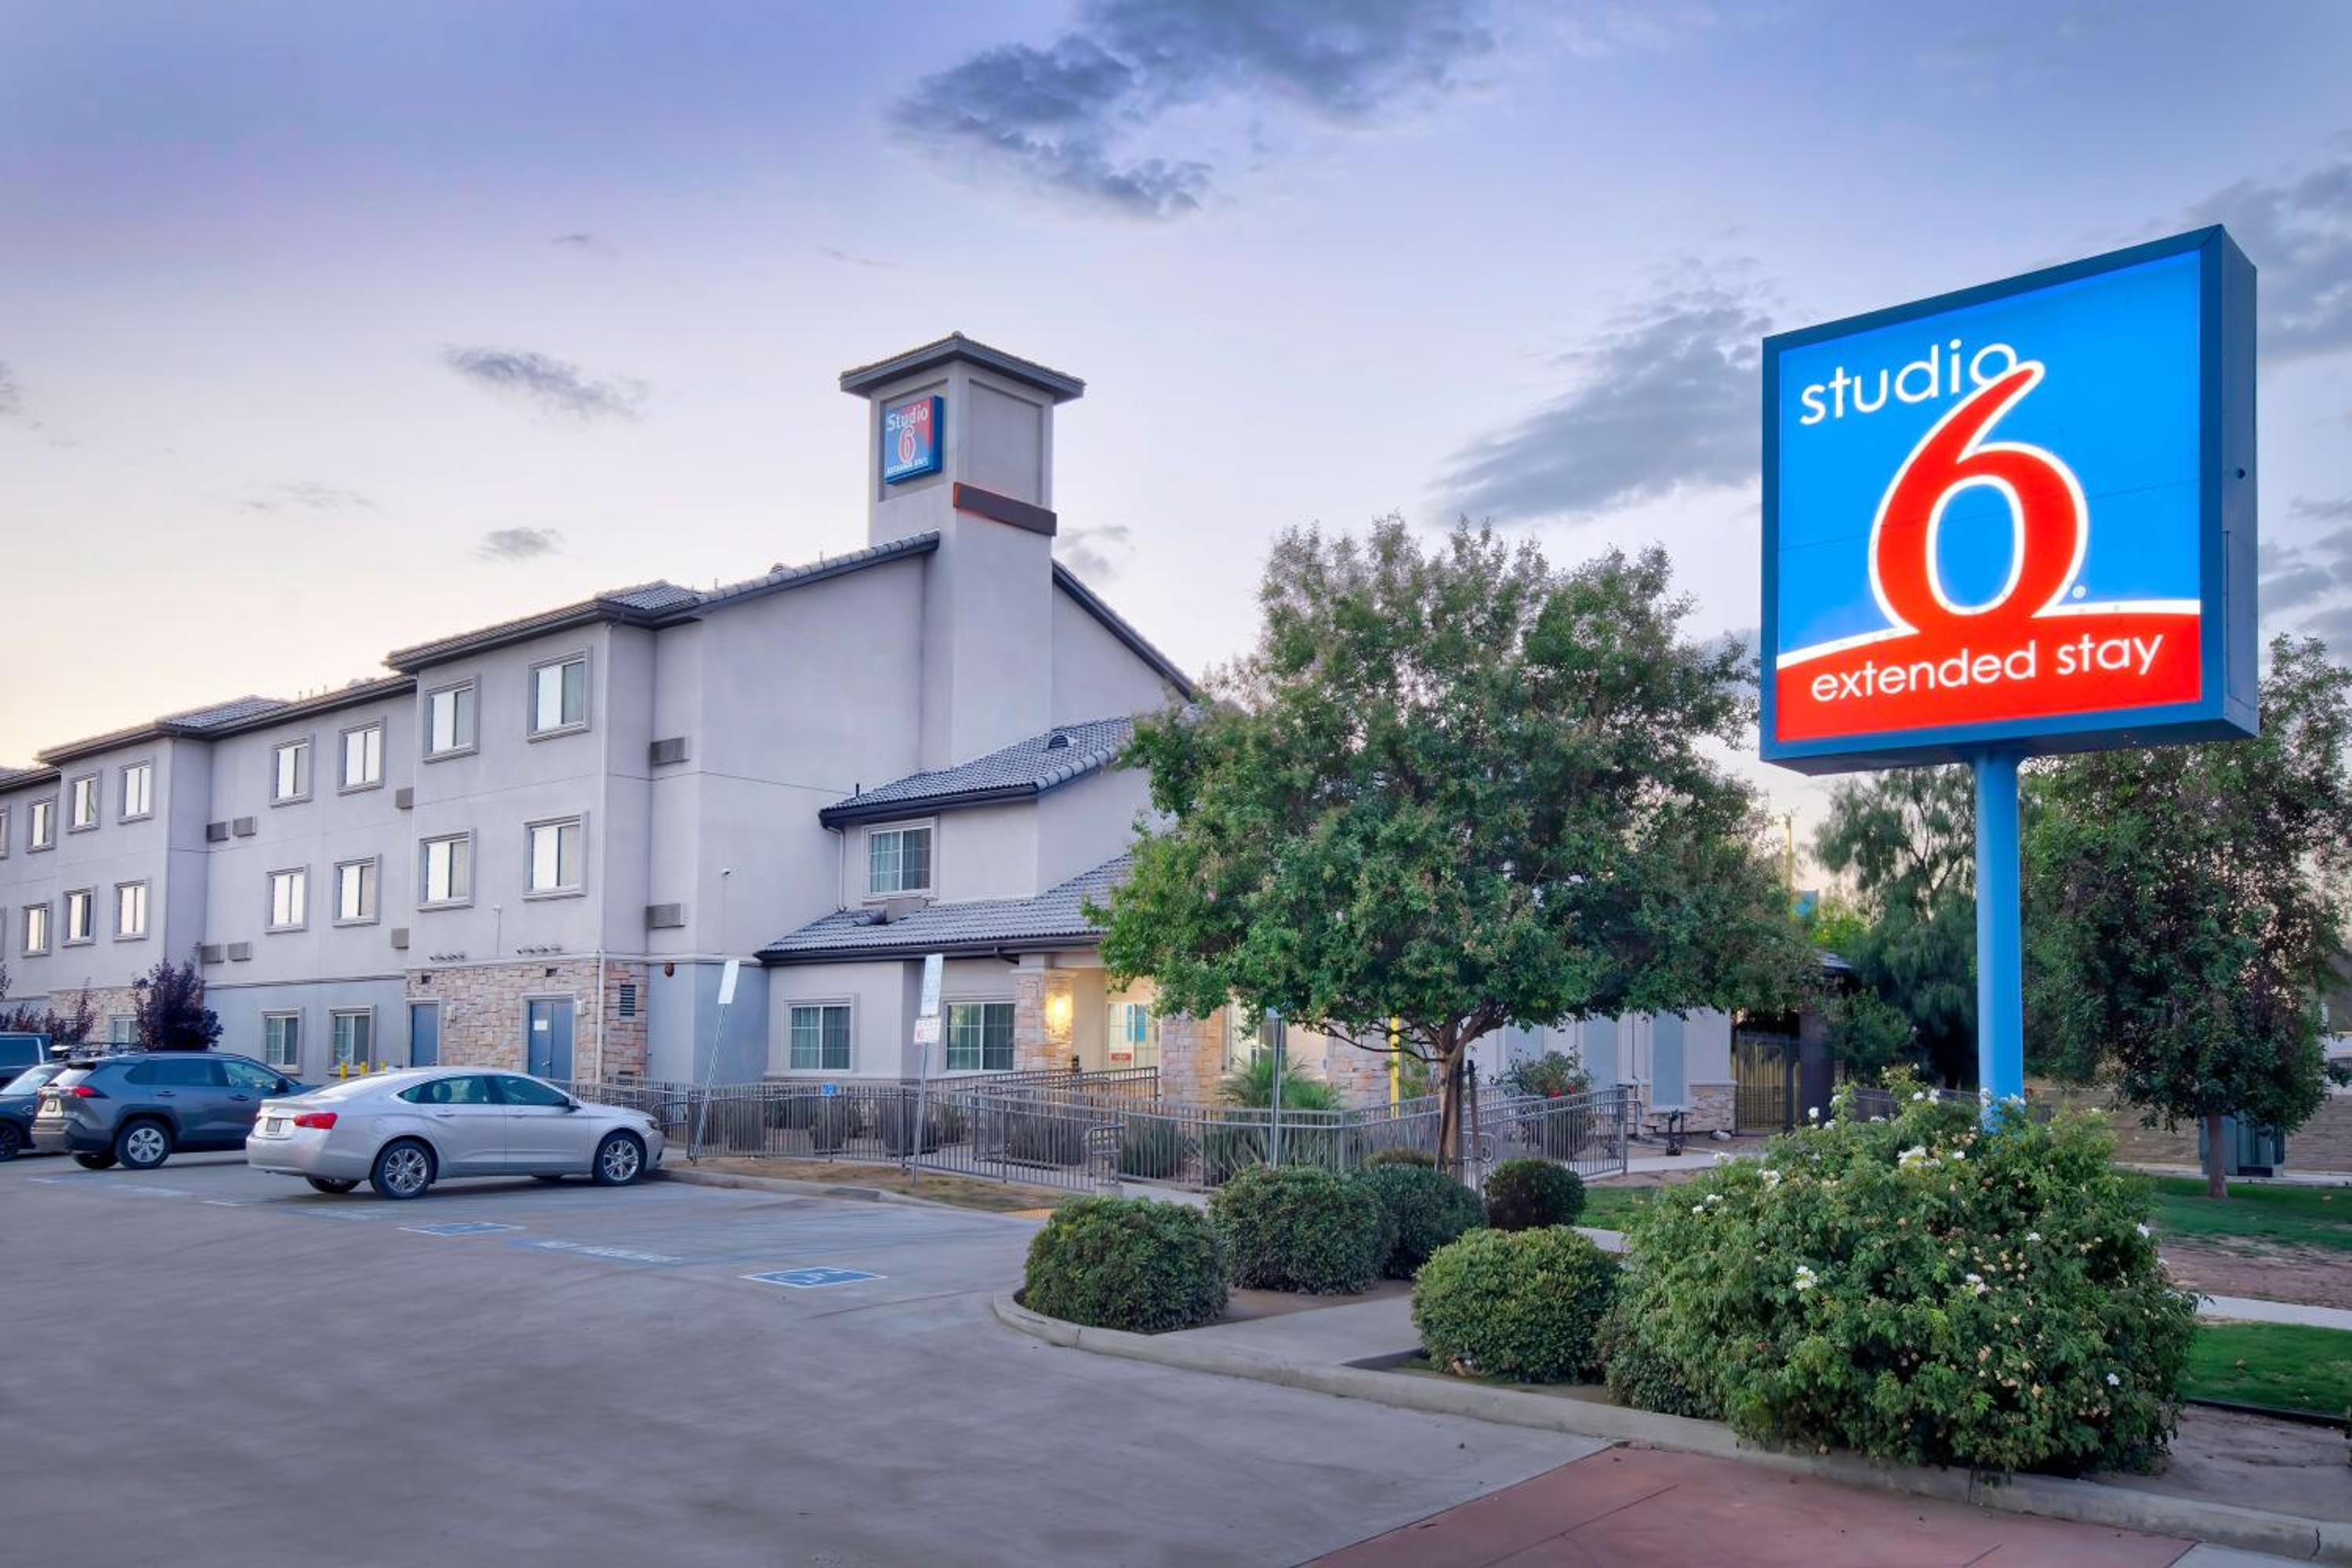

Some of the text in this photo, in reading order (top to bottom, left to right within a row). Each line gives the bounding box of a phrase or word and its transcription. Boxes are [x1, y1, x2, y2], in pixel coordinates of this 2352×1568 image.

[1800, 339, 2017, 424] studio
[887, 404, 928, 431] Studio
[898, 424, 916, 464] 6
[1868, 359, 2088, 633] 6
[1811, 633, 2164, 702] extended stay
